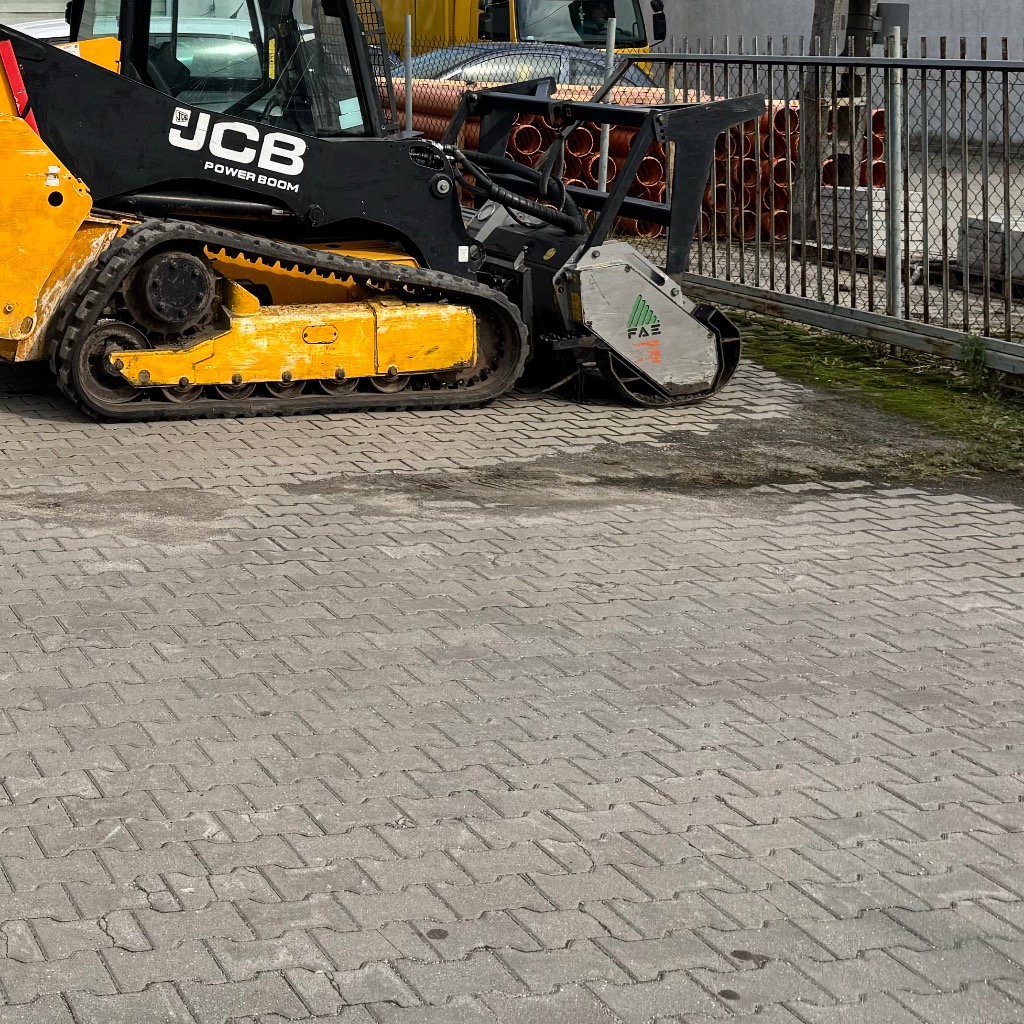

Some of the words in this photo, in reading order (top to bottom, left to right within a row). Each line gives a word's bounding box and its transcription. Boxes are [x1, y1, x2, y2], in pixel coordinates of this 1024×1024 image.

[168, 112, 307, 176] JCB
[204, 161, 256, 182] POWER
[257, 175, 299, 193] BOOM
[627, 324, 661, 340] FAE
